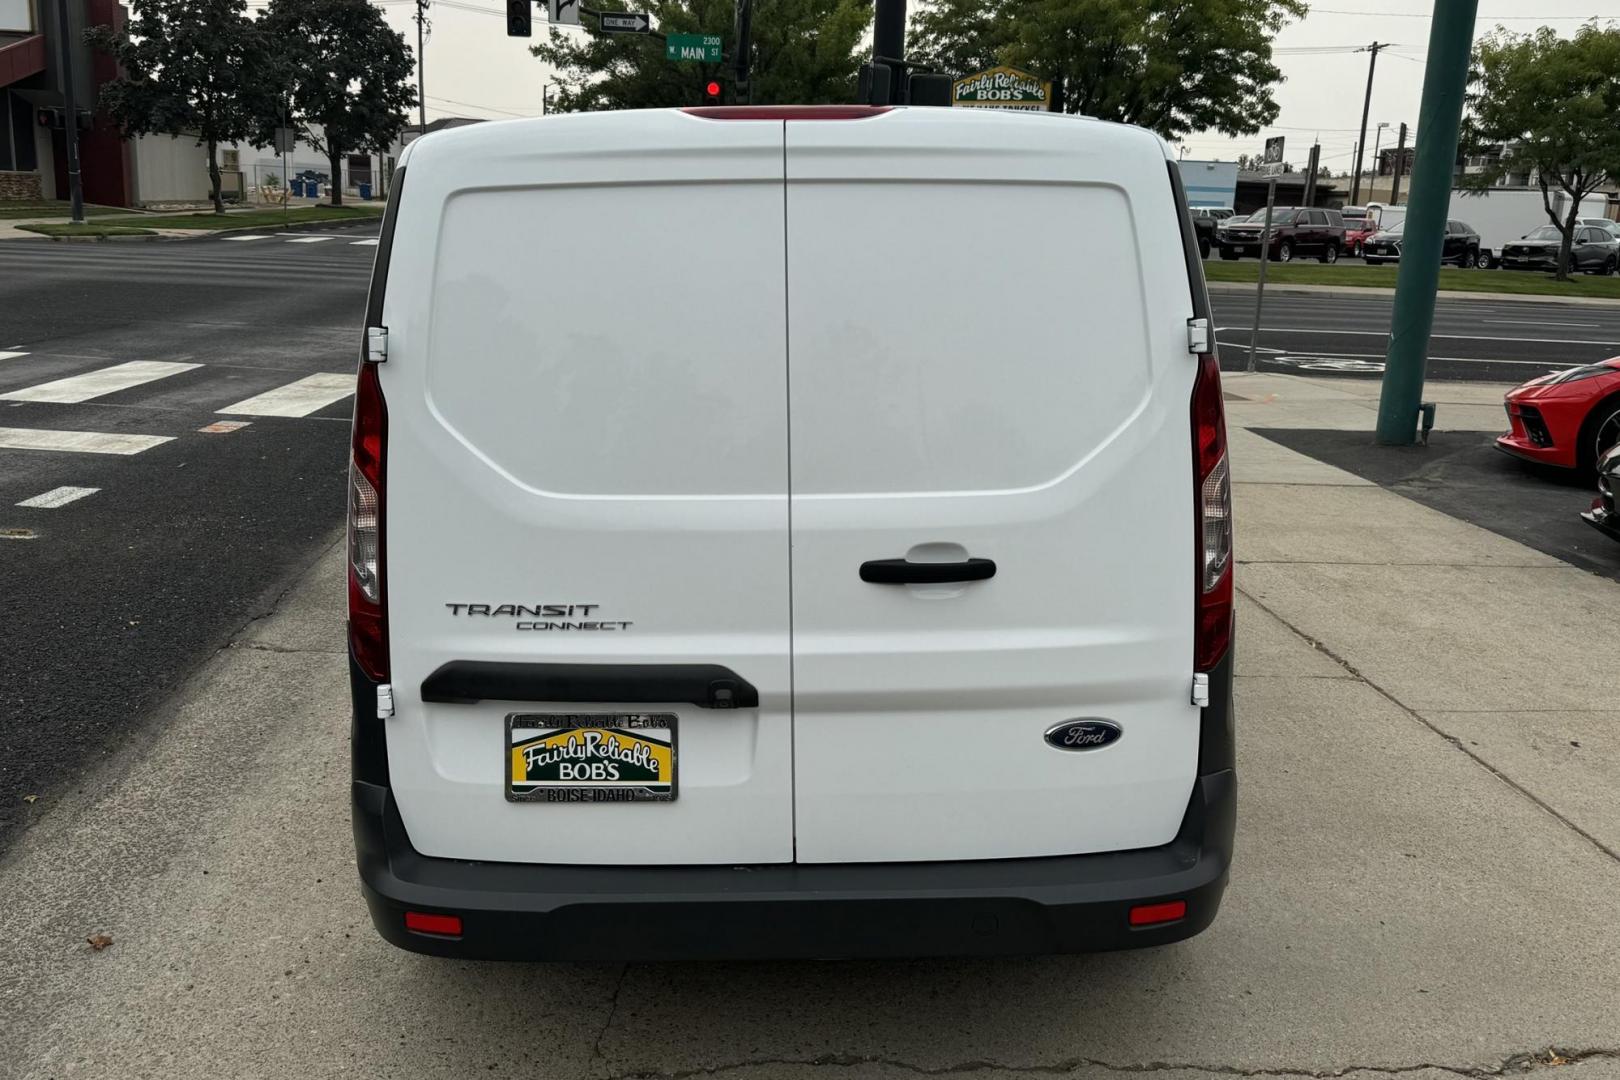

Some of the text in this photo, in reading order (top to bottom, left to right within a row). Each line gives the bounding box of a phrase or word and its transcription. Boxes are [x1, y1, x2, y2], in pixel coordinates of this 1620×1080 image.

[703, 36, 721, 46] 2300
[681, 46, 705, 60] MAIN
[711, 48, 719, 56] ST
[956, 73, 1045, 99] Fairly Reliable
[977, 89, 1023, 100] BOB'S
[445, 603, 600, 617] TRANSIT
[516, 621, 634, 631] CONNECT
[1064, 726, 1106, 745] Ford
[523, 732, 659, 772] Fairly Reliable
[559, 760, 620, 780] BOB'S
[592, 788, 635, 802] IDAHO
